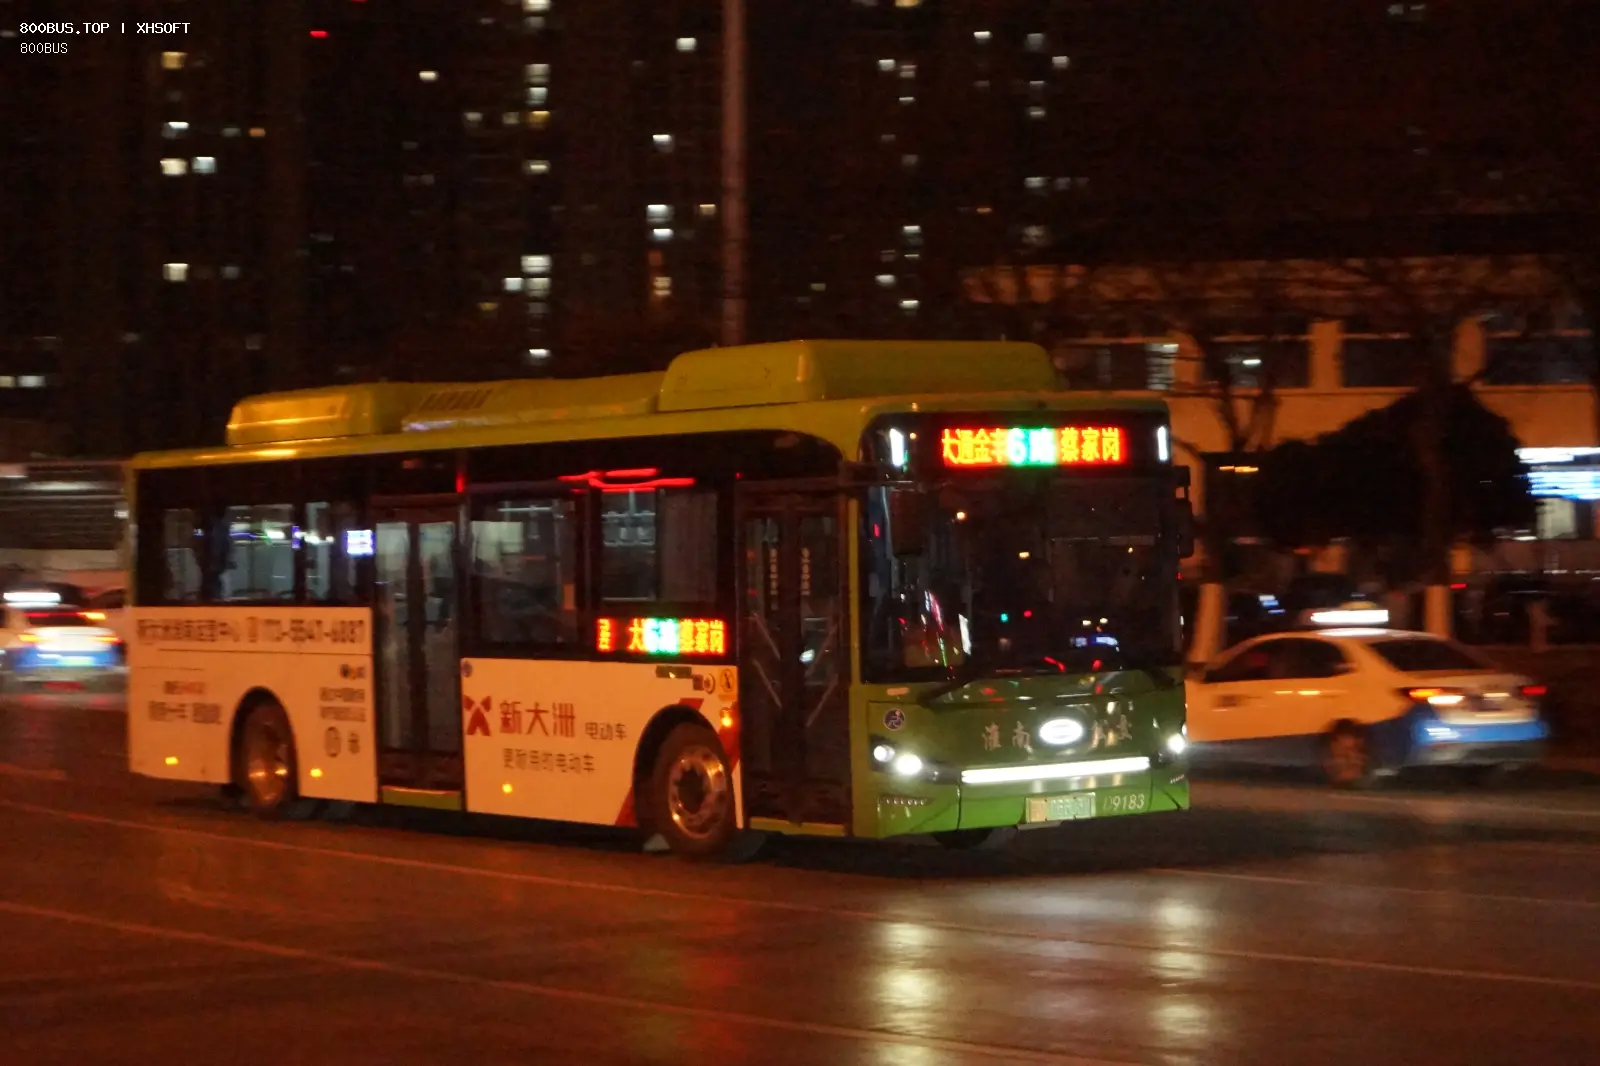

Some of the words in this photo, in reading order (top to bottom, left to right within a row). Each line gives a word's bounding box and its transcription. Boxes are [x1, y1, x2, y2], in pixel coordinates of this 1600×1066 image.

[499, 699, 576, 738] 新大洲
[584, 721, 628, 741] 电动车
[502, 747, 597, 775] 更耐用的电动车
